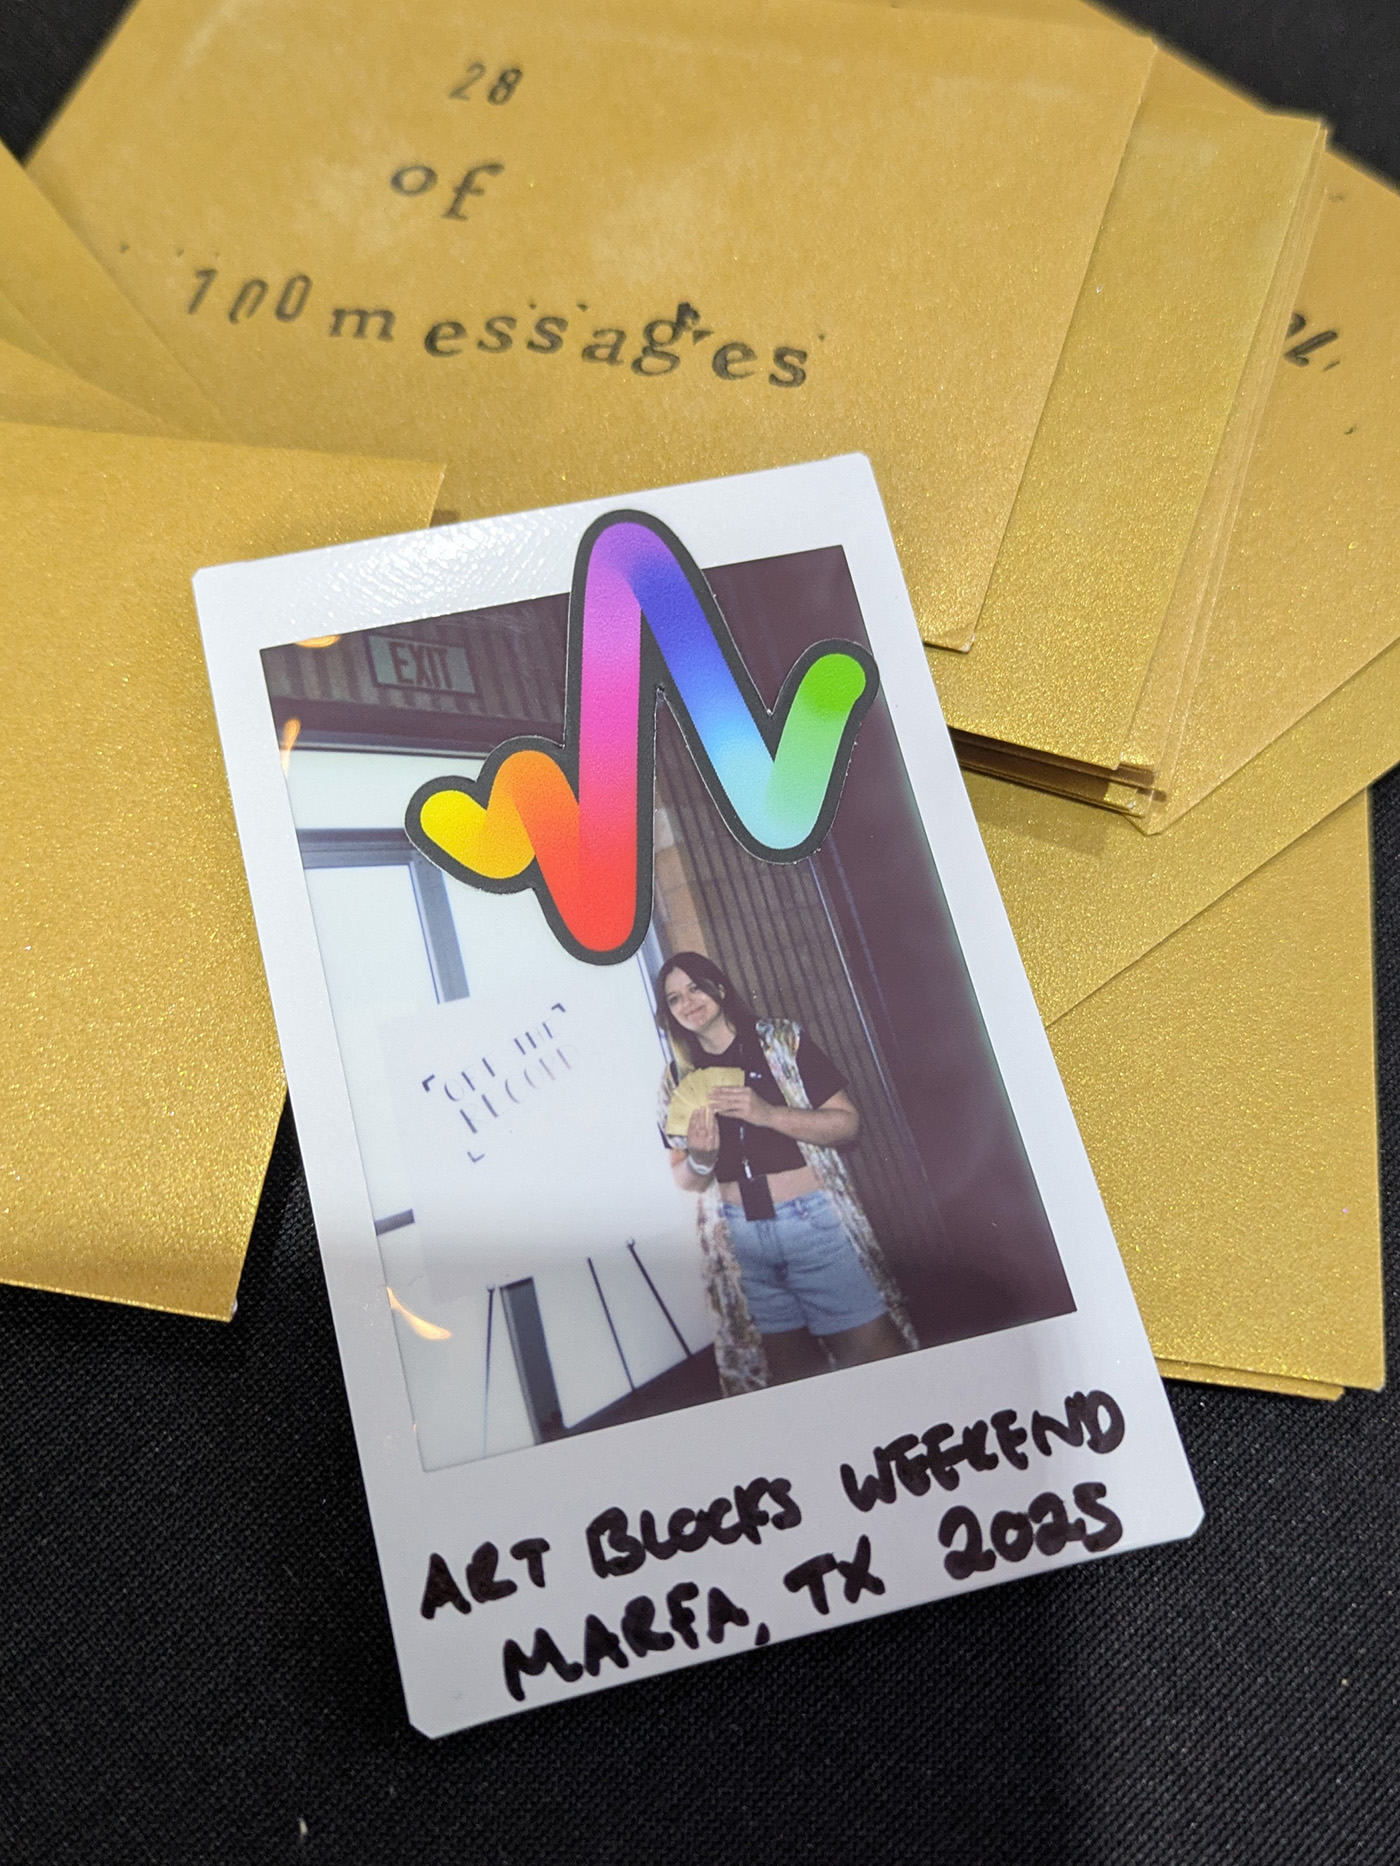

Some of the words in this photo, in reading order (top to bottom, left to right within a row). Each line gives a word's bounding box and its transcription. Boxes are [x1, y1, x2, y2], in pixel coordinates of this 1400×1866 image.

[448, 61, 523, 106] 28
[389, 161, 504, 221] of
[388, 641, 454, 689] EXIT
[420, 1538, 551, 1619] ART
[586, 1476, 802, 1578] BLOCKS
[840, 1389, 1126, 1512] WEEKEND
[502, 1582, 771, 1702] MARFA,
[784, 1534, 887, 1615] TX
[938, 1481, 1124, 1581] 2025
